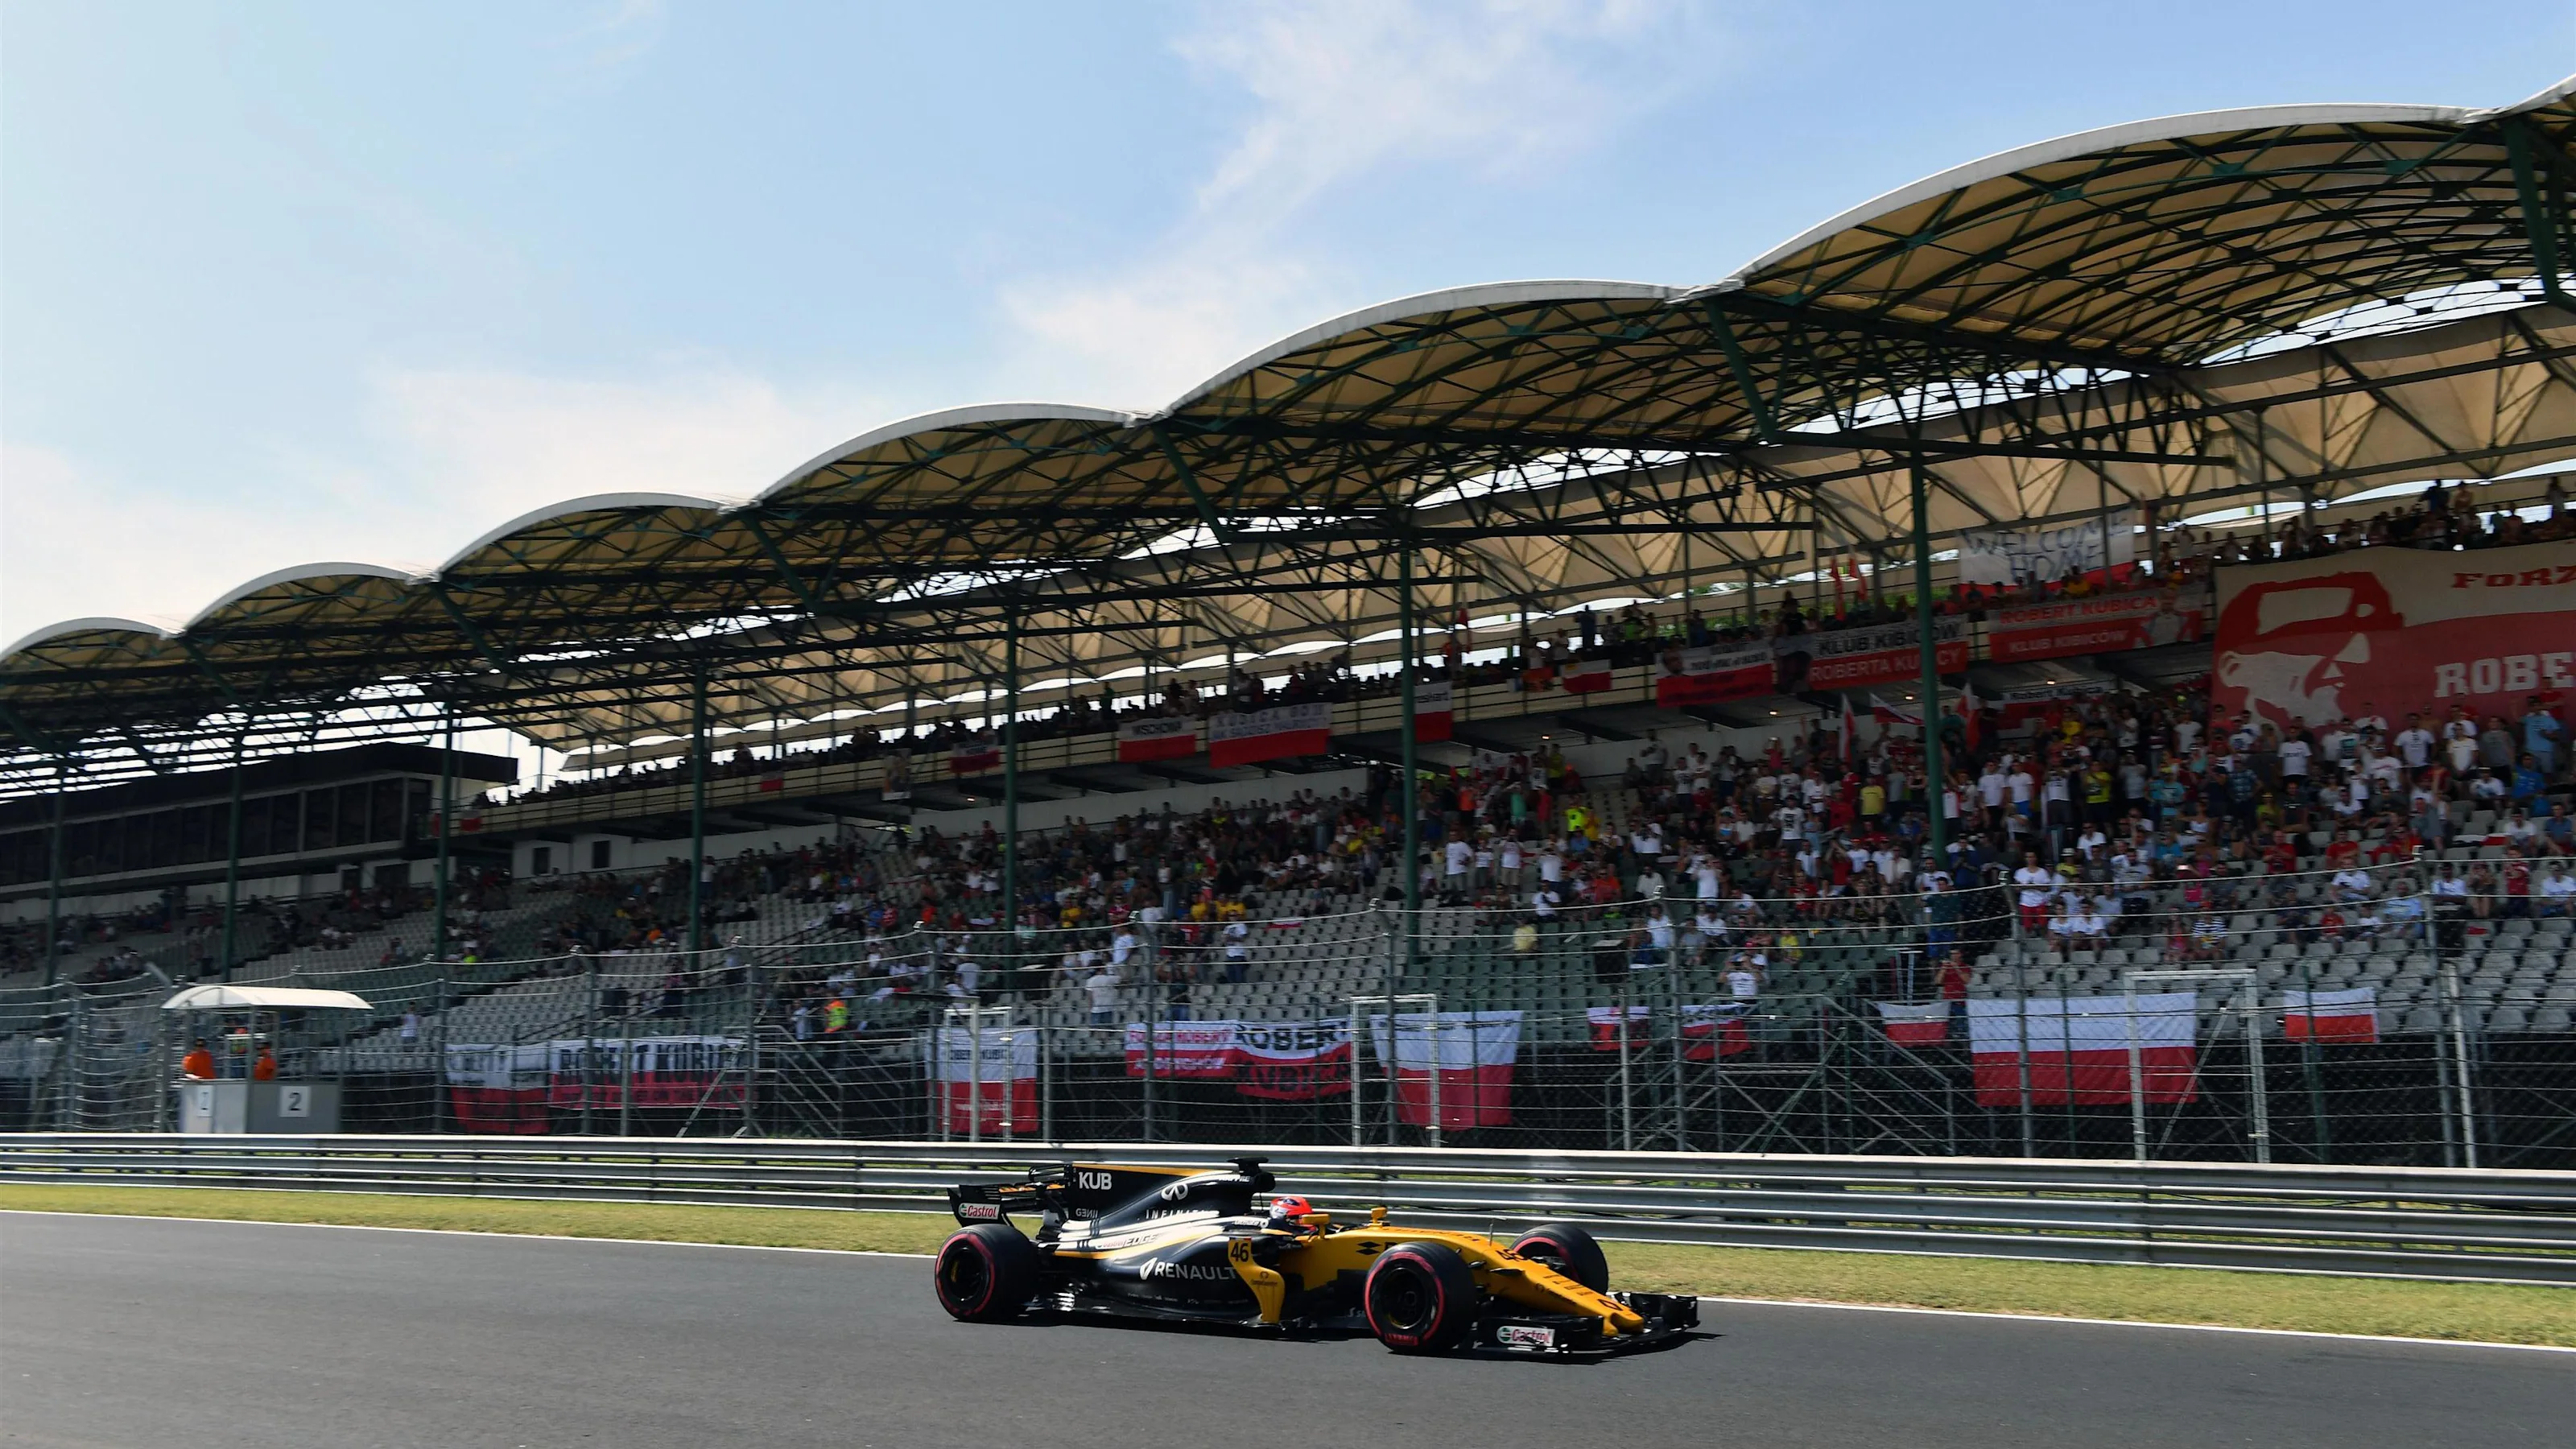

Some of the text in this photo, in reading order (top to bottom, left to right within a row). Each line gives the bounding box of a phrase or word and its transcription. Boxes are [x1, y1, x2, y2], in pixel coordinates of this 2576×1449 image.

[2000, 596, 2158, 625] ROBERT KUBICA
[1818, 634, 1871, 655] KLUB
[2008, 638, 2054, 654] KLUB
[1809, 646, 1961, 682] ROBERTA KUCY
[288, 1092, 301, 1111] 2
[1078, 1171, 1113, 1191] KUB
[968, 1205, 997, 1218] Castrol
[1230, 1242, 1249, 1262] 46
[1154, 1261, 1236, 1281] RENAULT
